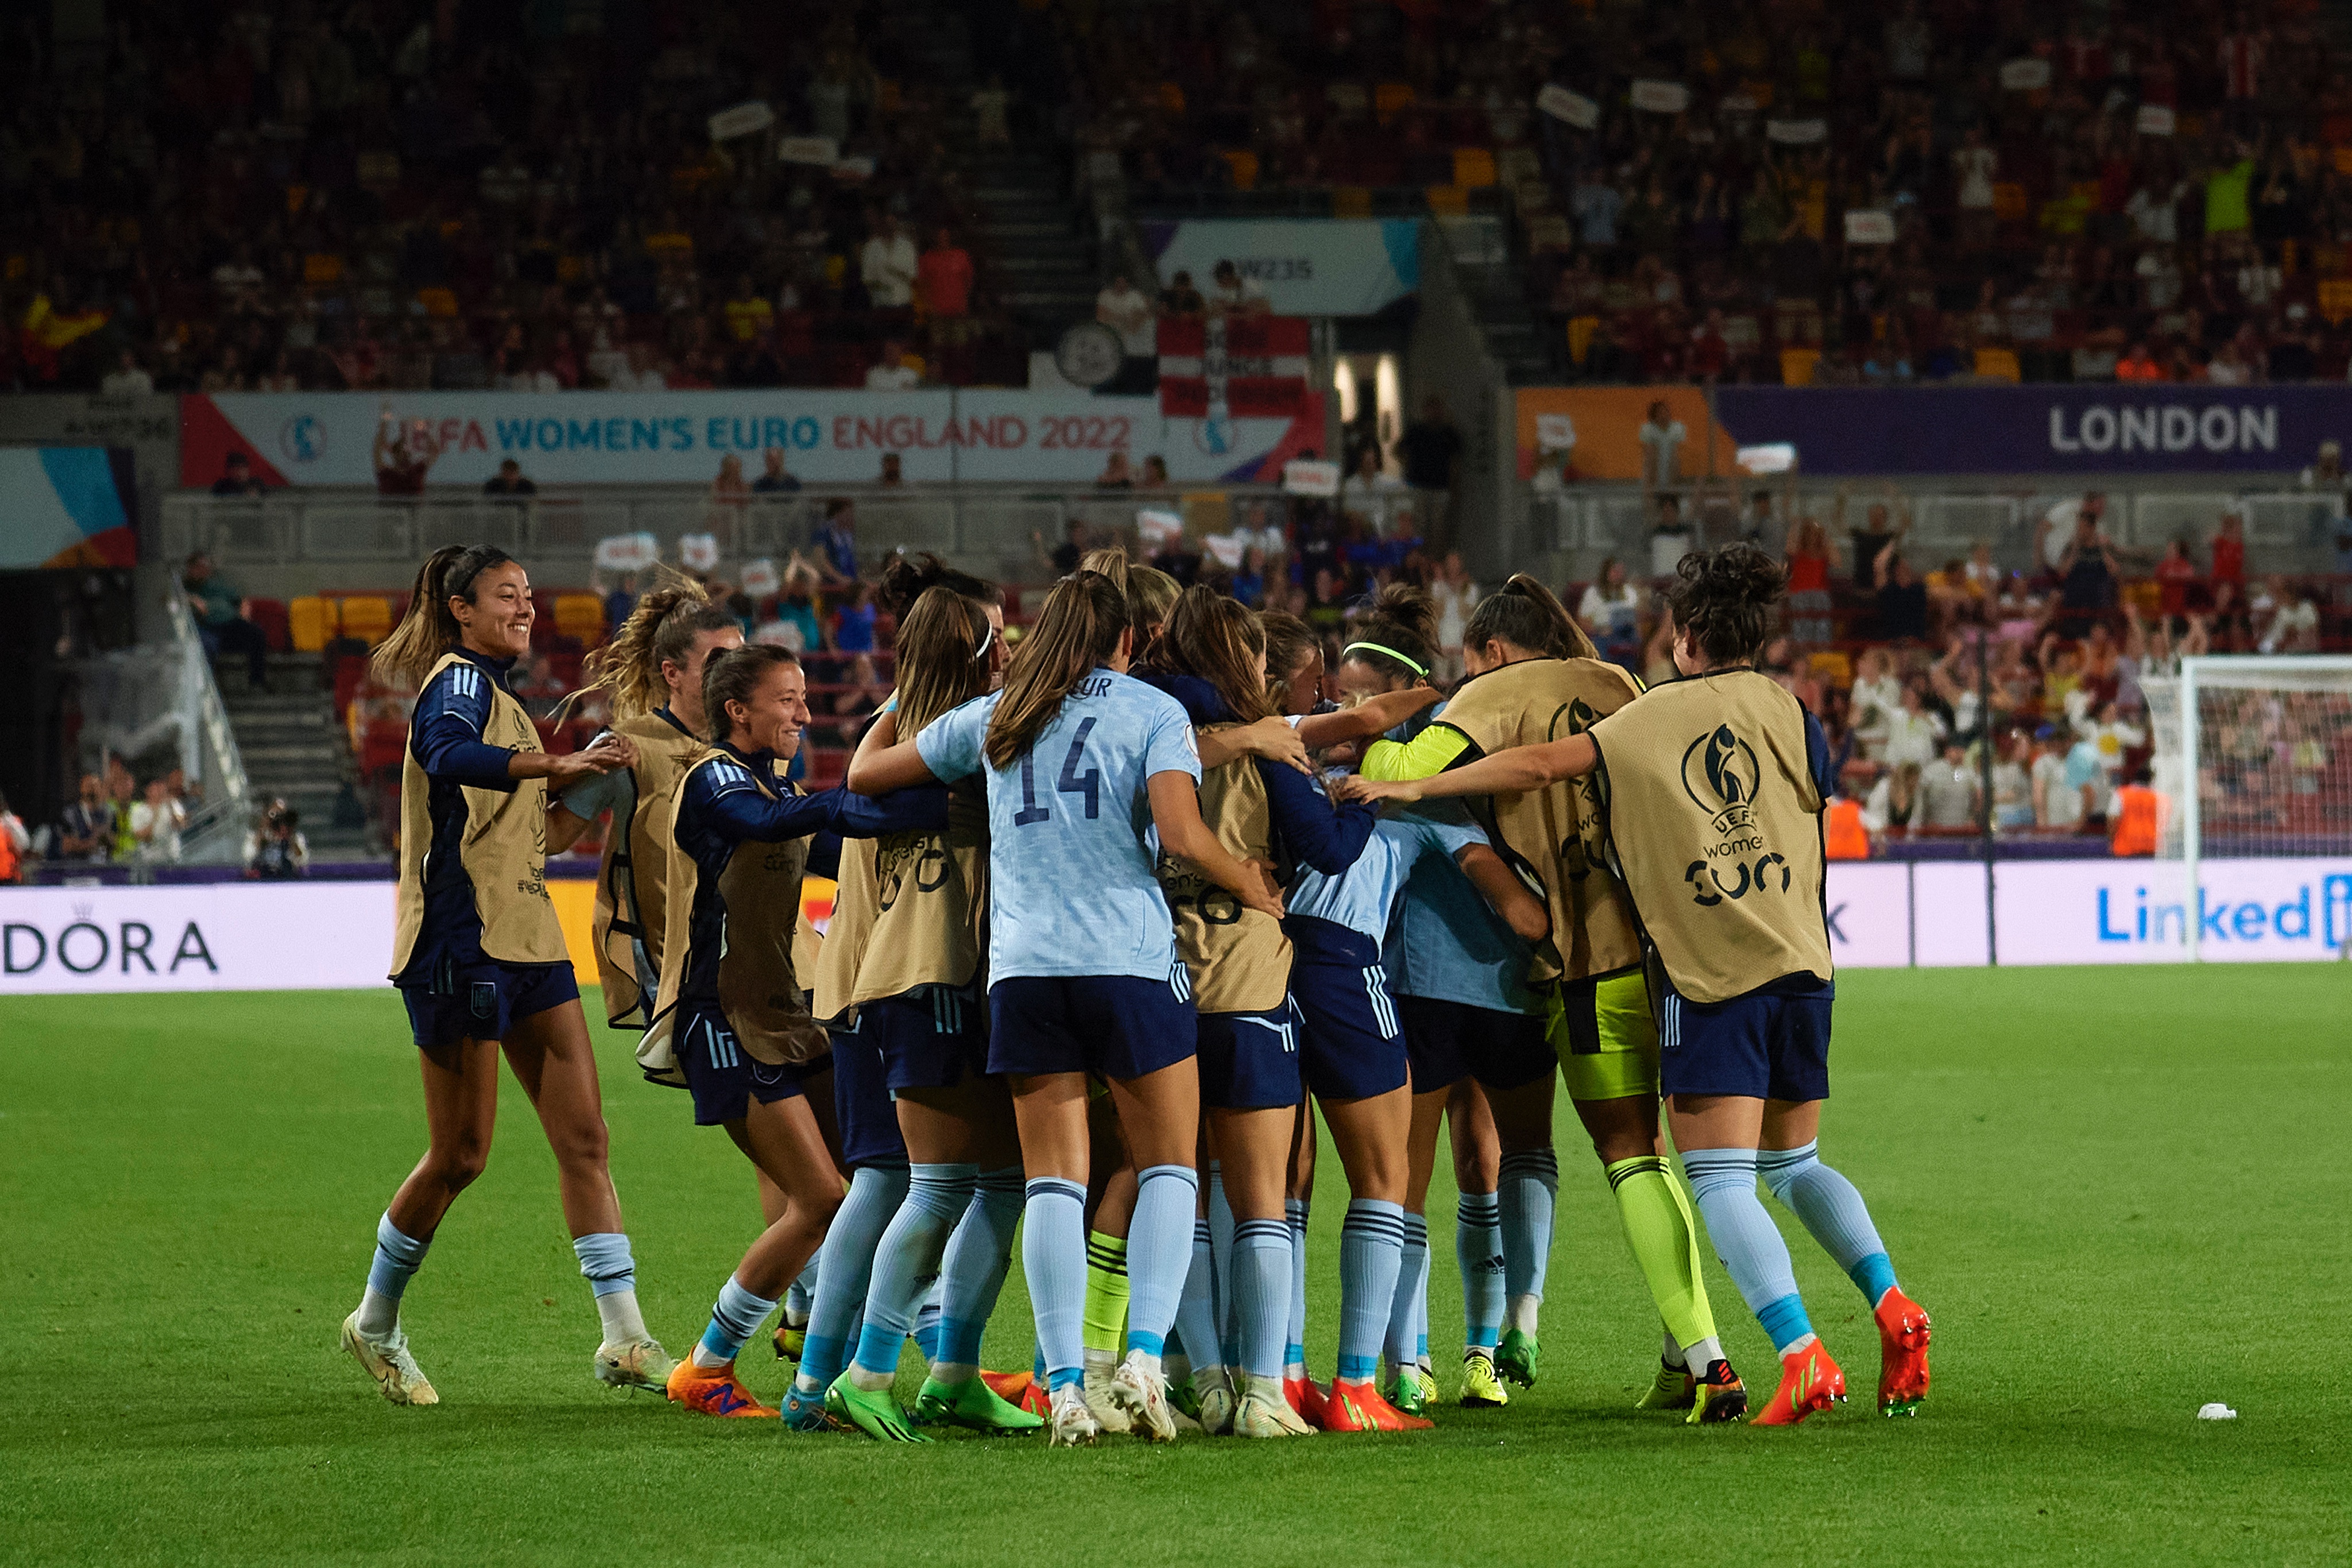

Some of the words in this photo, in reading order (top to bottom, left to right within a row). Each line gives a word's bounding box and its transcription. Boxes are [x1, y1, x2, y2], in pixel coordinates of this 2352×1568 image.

[496, 417, 693, 452] WOMEN'S
[707, 416, 820, 451] EURO
[832, 415, 1028, 450] ENGLAND
[1039, 415, 1131, 450] 2022
[2049, 404, 2279, 452] LONDON
[1081, 678, 1112, 697] UR
[1015, 717, 1099, 827] 14
[1704, 837, 1764, 858] wome
[3, 921, 218, 974] DORA
